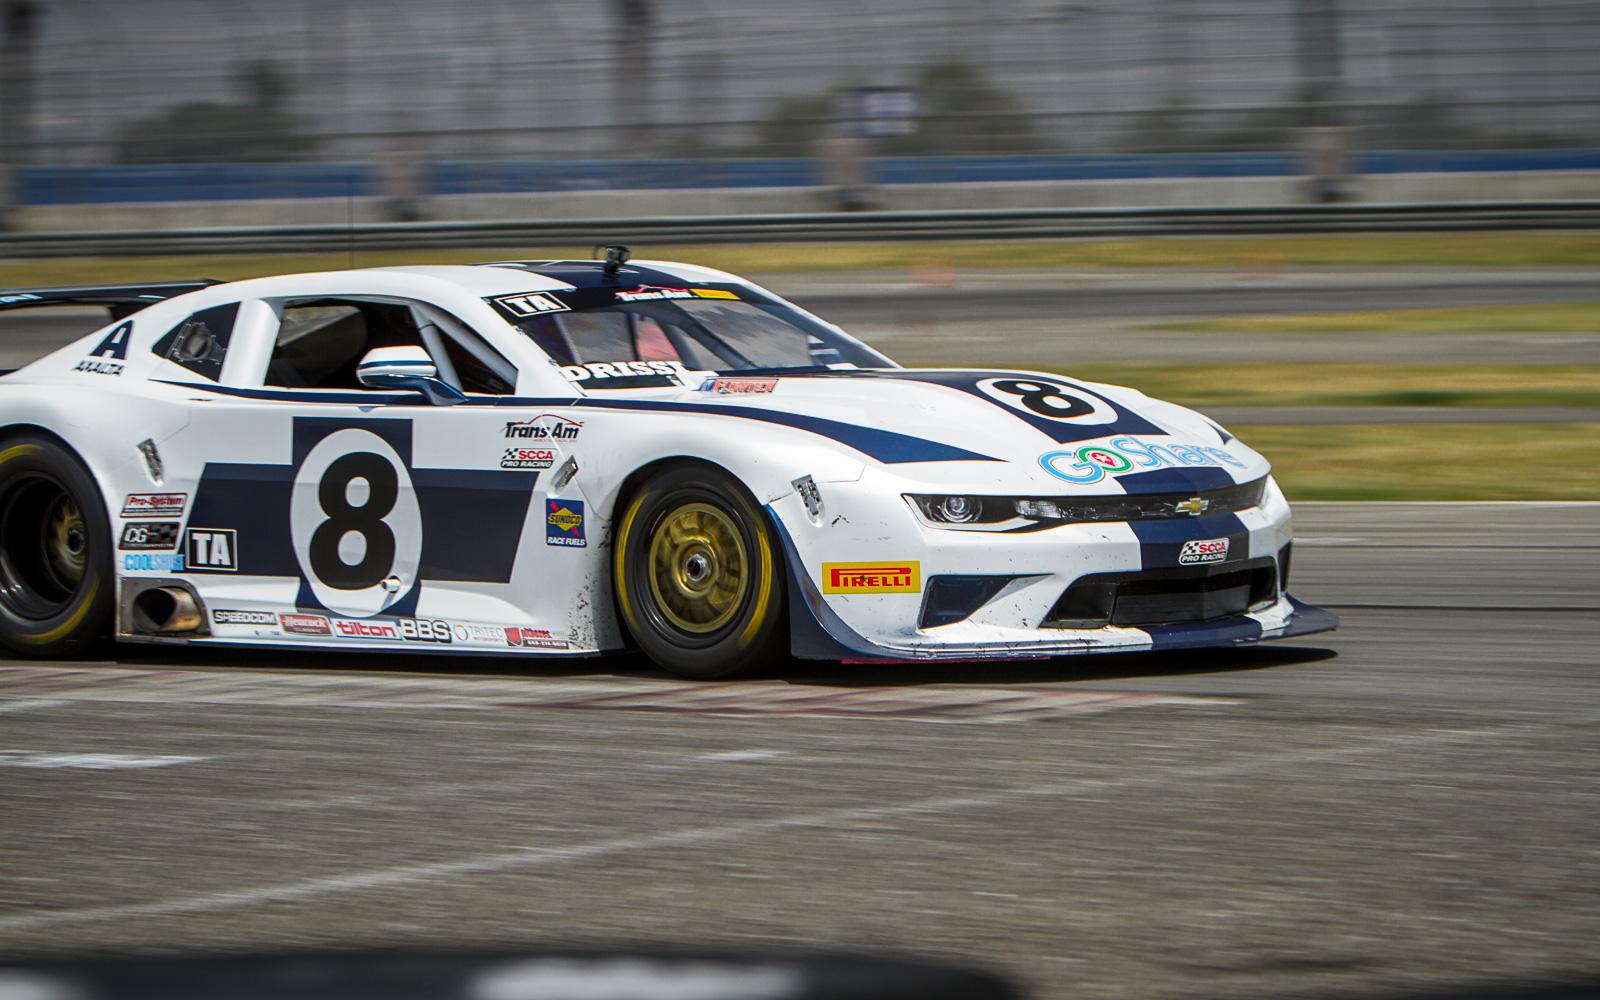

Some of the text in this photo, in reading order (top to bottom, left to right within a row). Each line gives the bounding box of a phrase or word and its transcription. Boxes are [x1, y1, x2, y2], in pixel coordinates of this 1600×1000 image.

[506, 294, 556, 313] TA
[993, 380, 1096, 418] 8
[518, 450, 554, 460] SCCA
[501, 460, 552, 468] PRO RACING
[309, 451, 400, 591] 8
[191, 532, 231, 566] TA
[547, 536, 586, 547] RACE FUELS
[1199, 541, 1226, 552] SCCA
[831, 568, 911, 588] PIRELLI
[214, 611, 276, 624] SPEEDCOM
[336, 621, 397, 637] tilton
[400, 618, 452, 643] BBS
